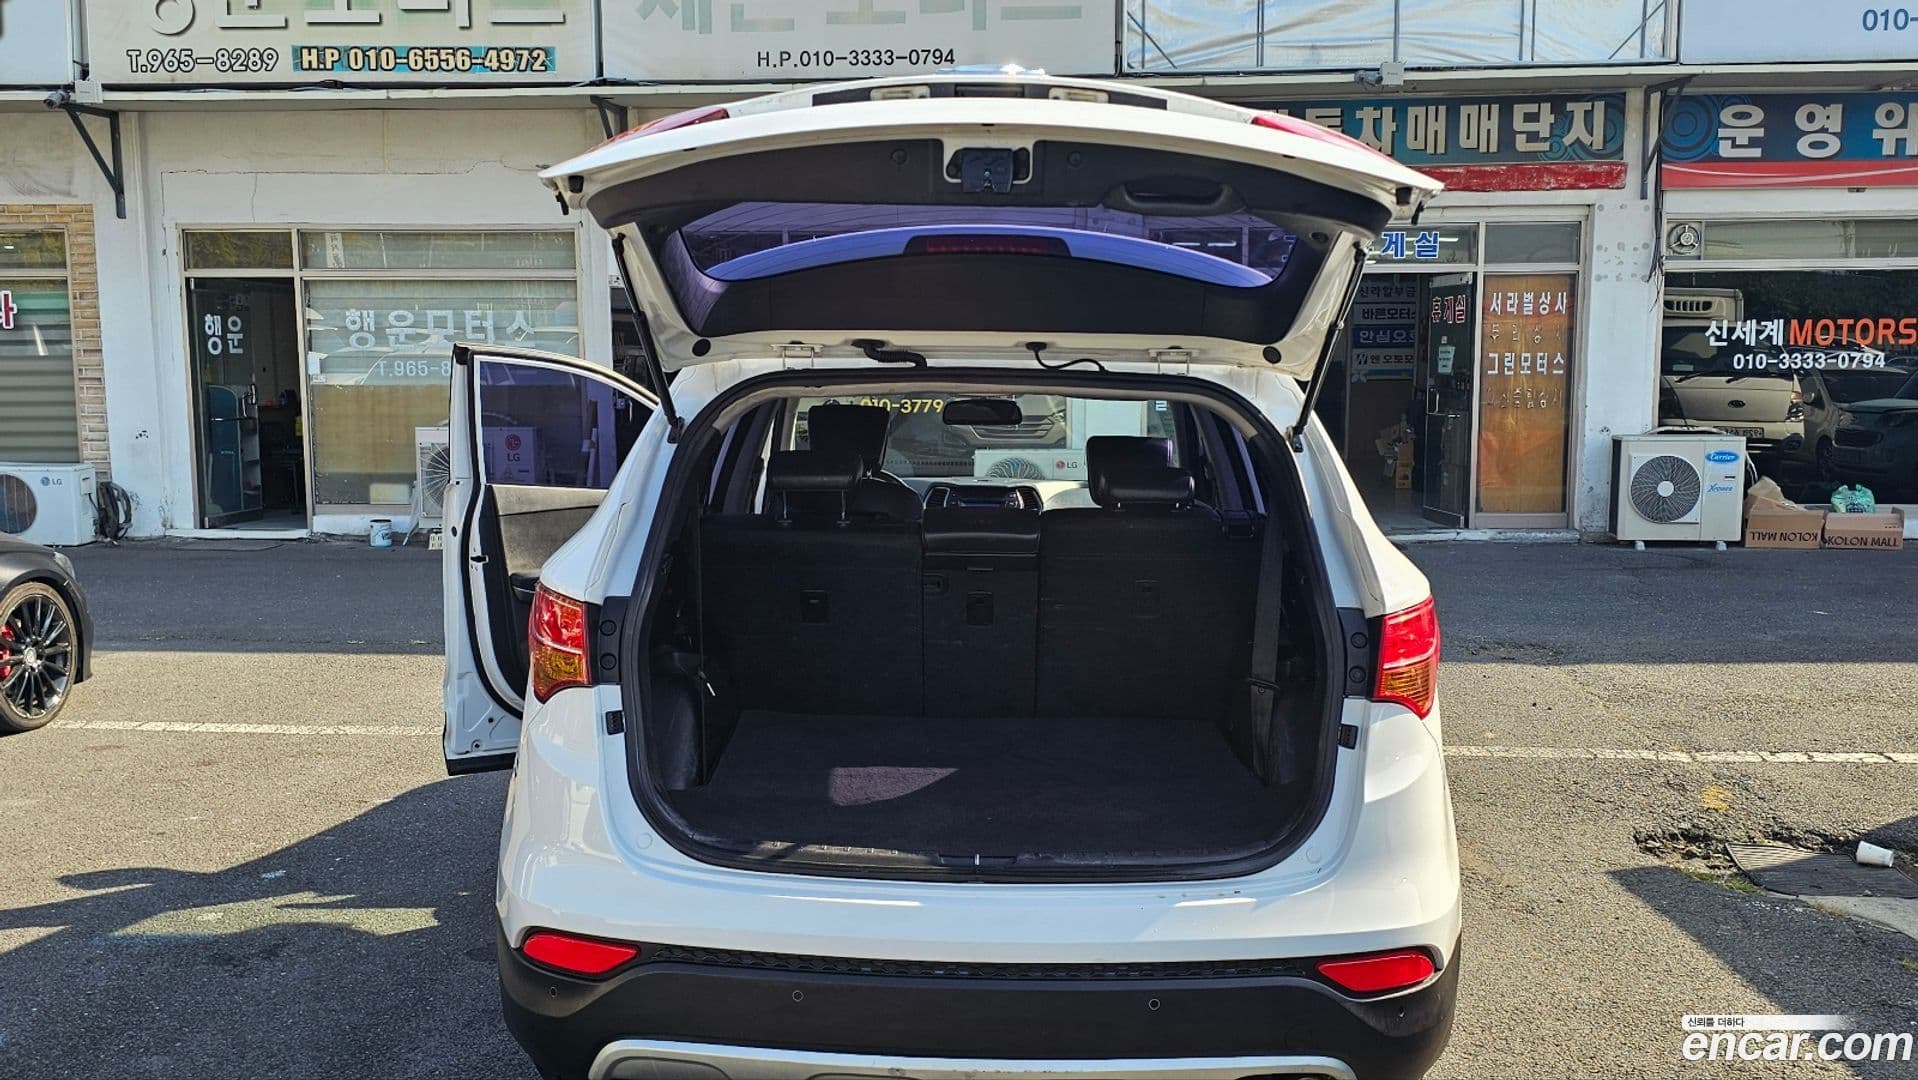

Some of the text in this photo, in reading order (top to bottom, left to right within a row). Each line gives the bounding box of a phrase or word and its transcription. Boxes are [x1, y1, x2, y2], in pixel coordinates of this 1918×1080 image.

[126, 46, 549, 72] T.965-8289 H.P 010-6556-4972
[756, 48, 956, 69] H.P.010-3333-0794
[1381, 231, 1440, 259] 게실
[1490, 291, 1567, 316] 서라벌상사
[204, 313, 243, 355] 행운
[1704, 318, 1918, 347] 신세계 MOTORS
[1487, 352, 1564, 375] 그린모터스
[1733, 352, 1886, 370] 010-3333-0794
[507, 453, 520, 462] LG
[1066, 461, 1078, 469] LG
[1708, 450, 1737, 461] Carrier
[1750, 531, 1818, 542] KOLON MALL
[1827, 535, 1899, 547] KOLON MALL
